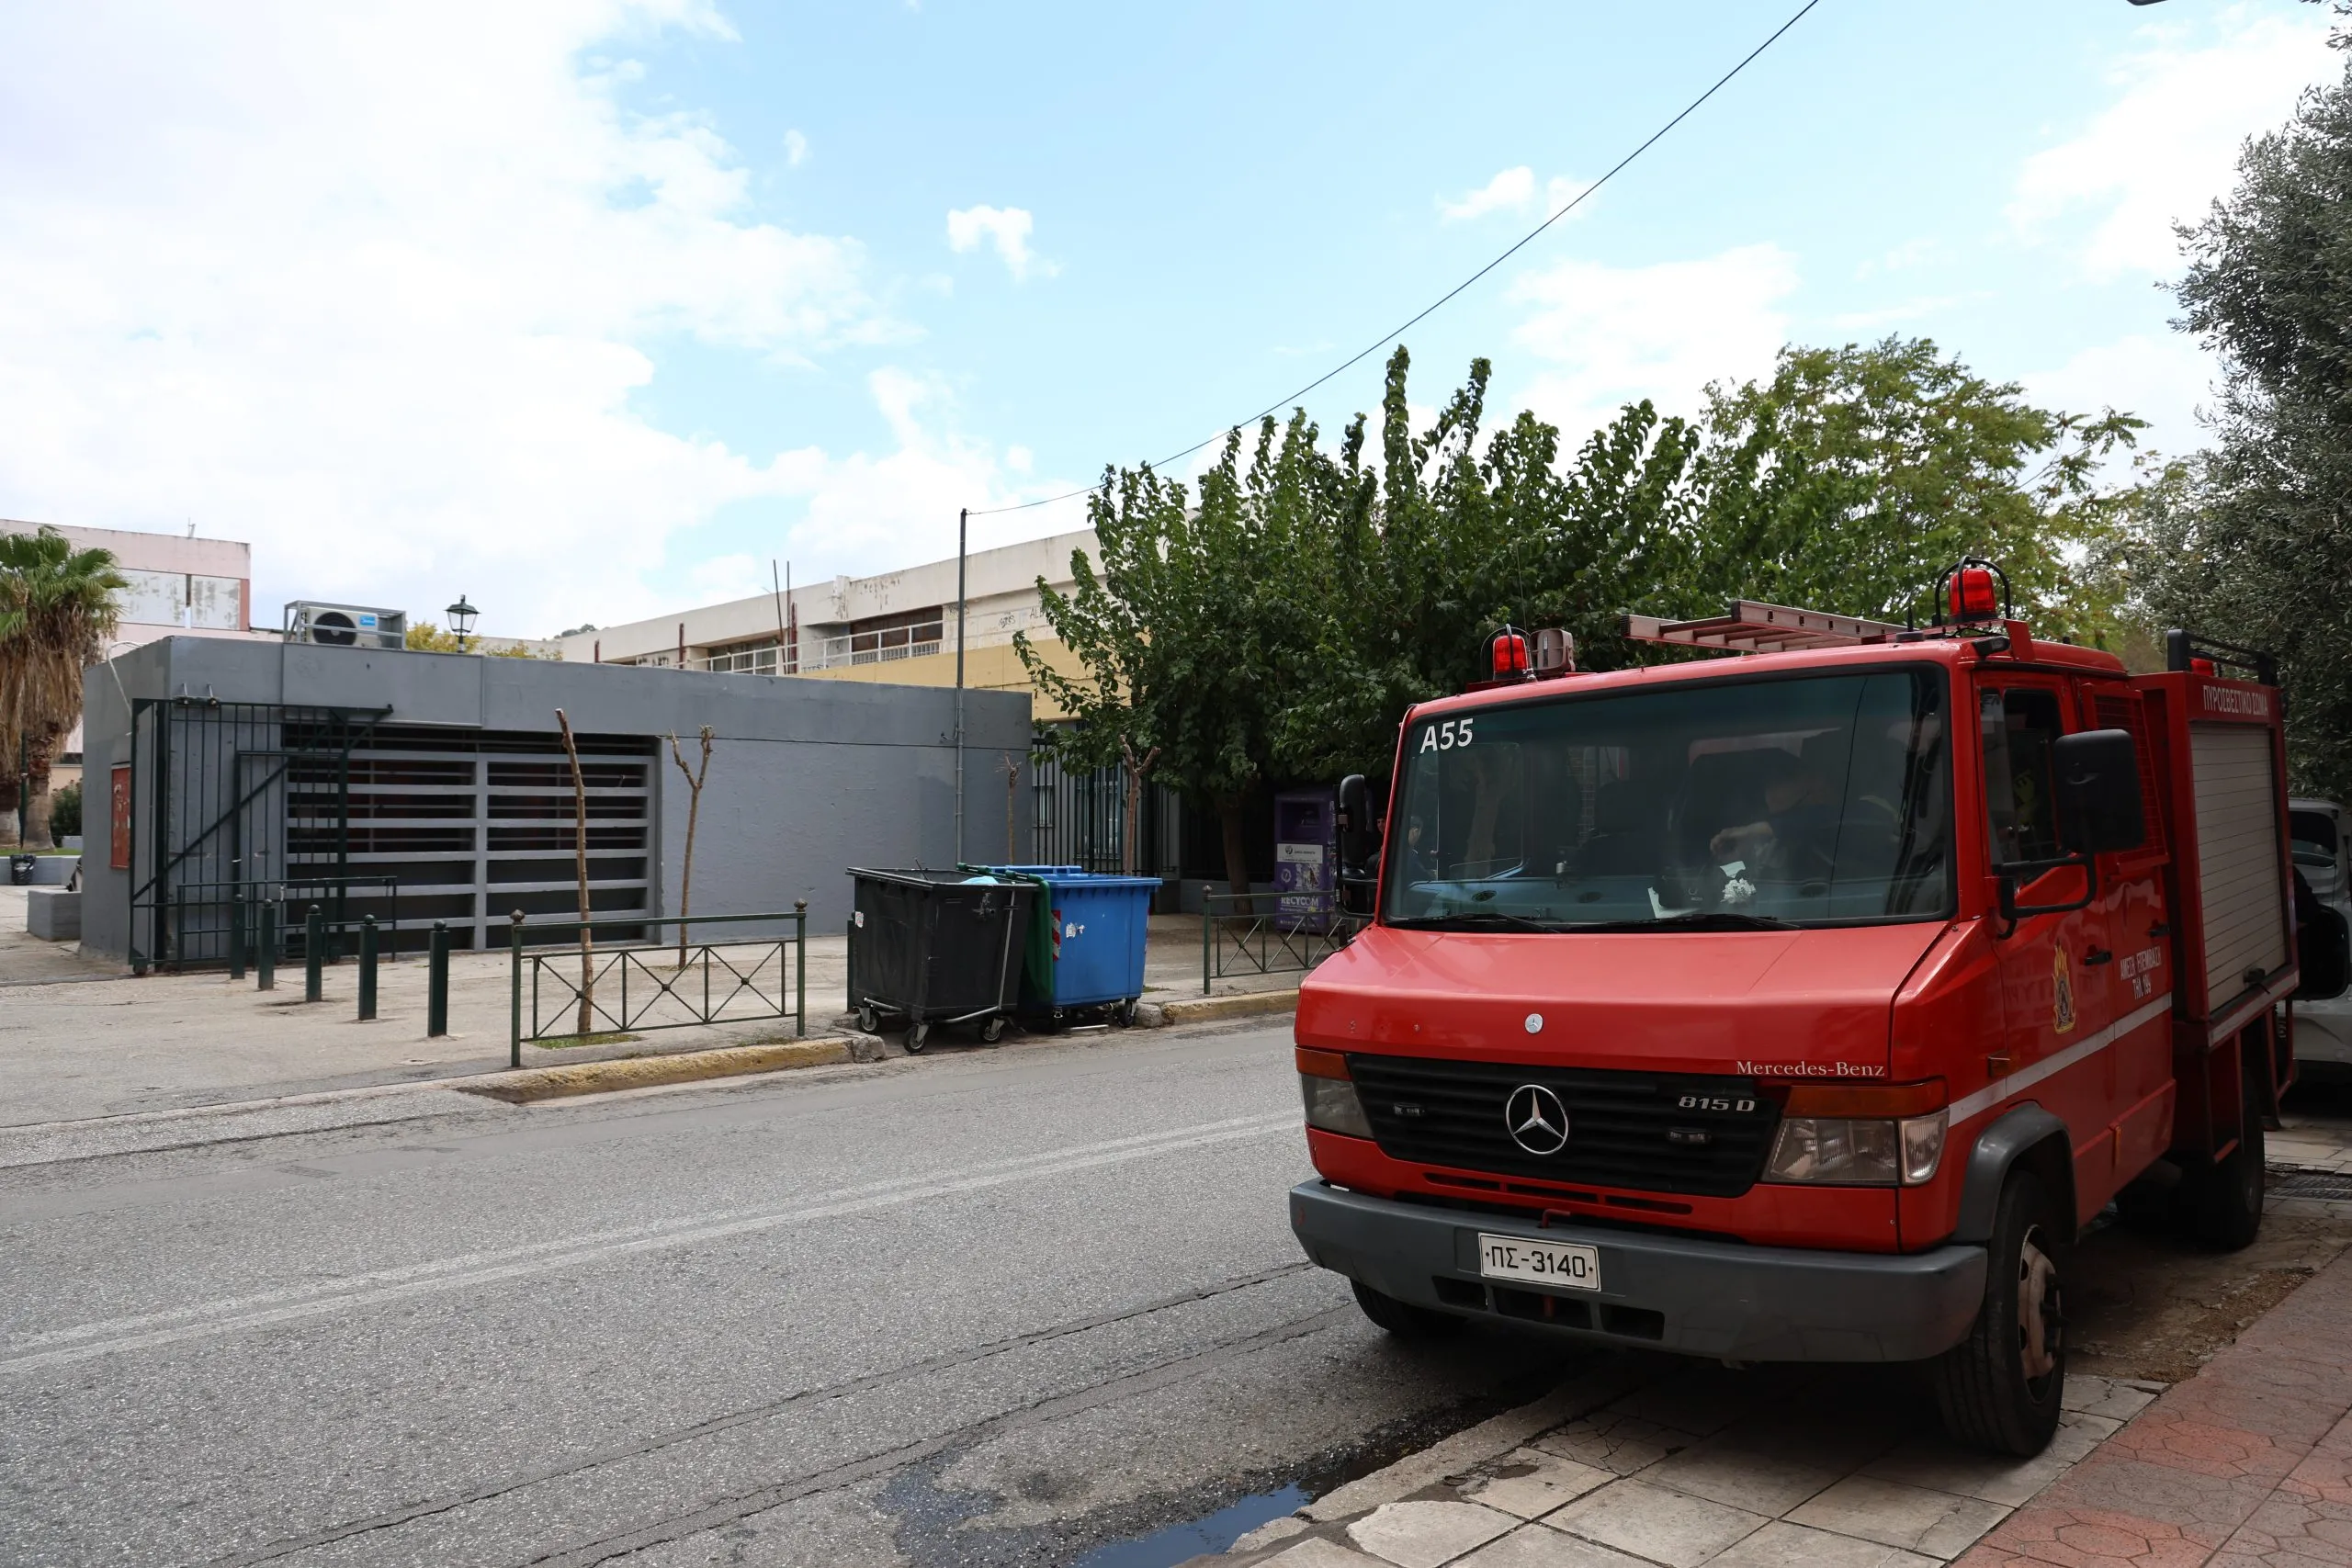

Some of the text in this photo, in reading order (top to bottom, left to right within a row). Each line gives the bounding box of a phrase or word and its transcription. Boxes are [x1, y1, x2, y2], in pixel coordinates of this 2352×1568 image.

[2203, 684, 2252, 715] ΠΥΡΟΣΒΕΣΤΙΚΟ
[1419, 717, 1474, 754] A55
[1736, 1060, 1885, 1077] Mercedes-Benz
[1679, 1096, 1756, 1112] 815 D
[1491, 1246, 1586, 1279] ΠΣ-3140
